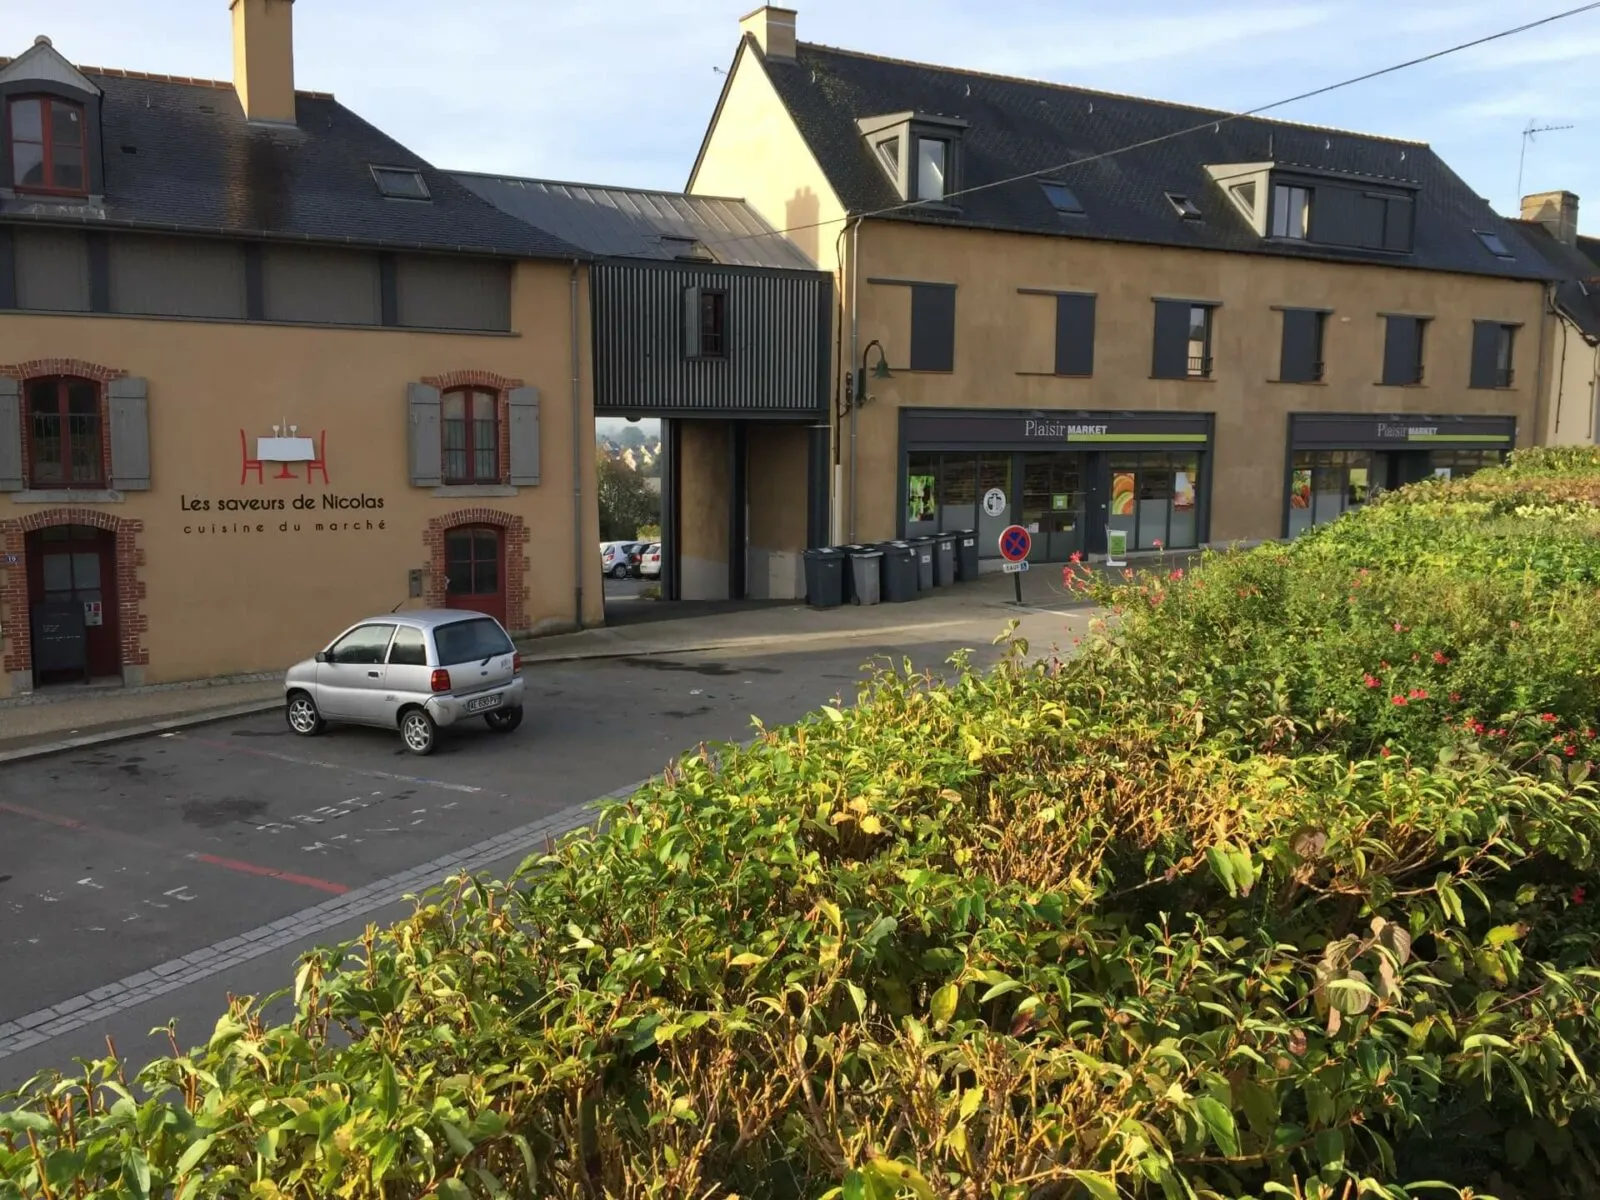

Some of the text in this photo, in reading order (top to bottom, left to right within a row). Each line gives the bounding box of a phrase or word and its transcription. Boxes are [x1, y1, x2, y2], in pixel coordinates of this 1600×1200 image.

[1024, 419, 1107, 437] Plaisir MARKET
[181, 493, 385, 511] Les saveurs de Nicolas
[183, 519, 386, 534] cuisine du marché
